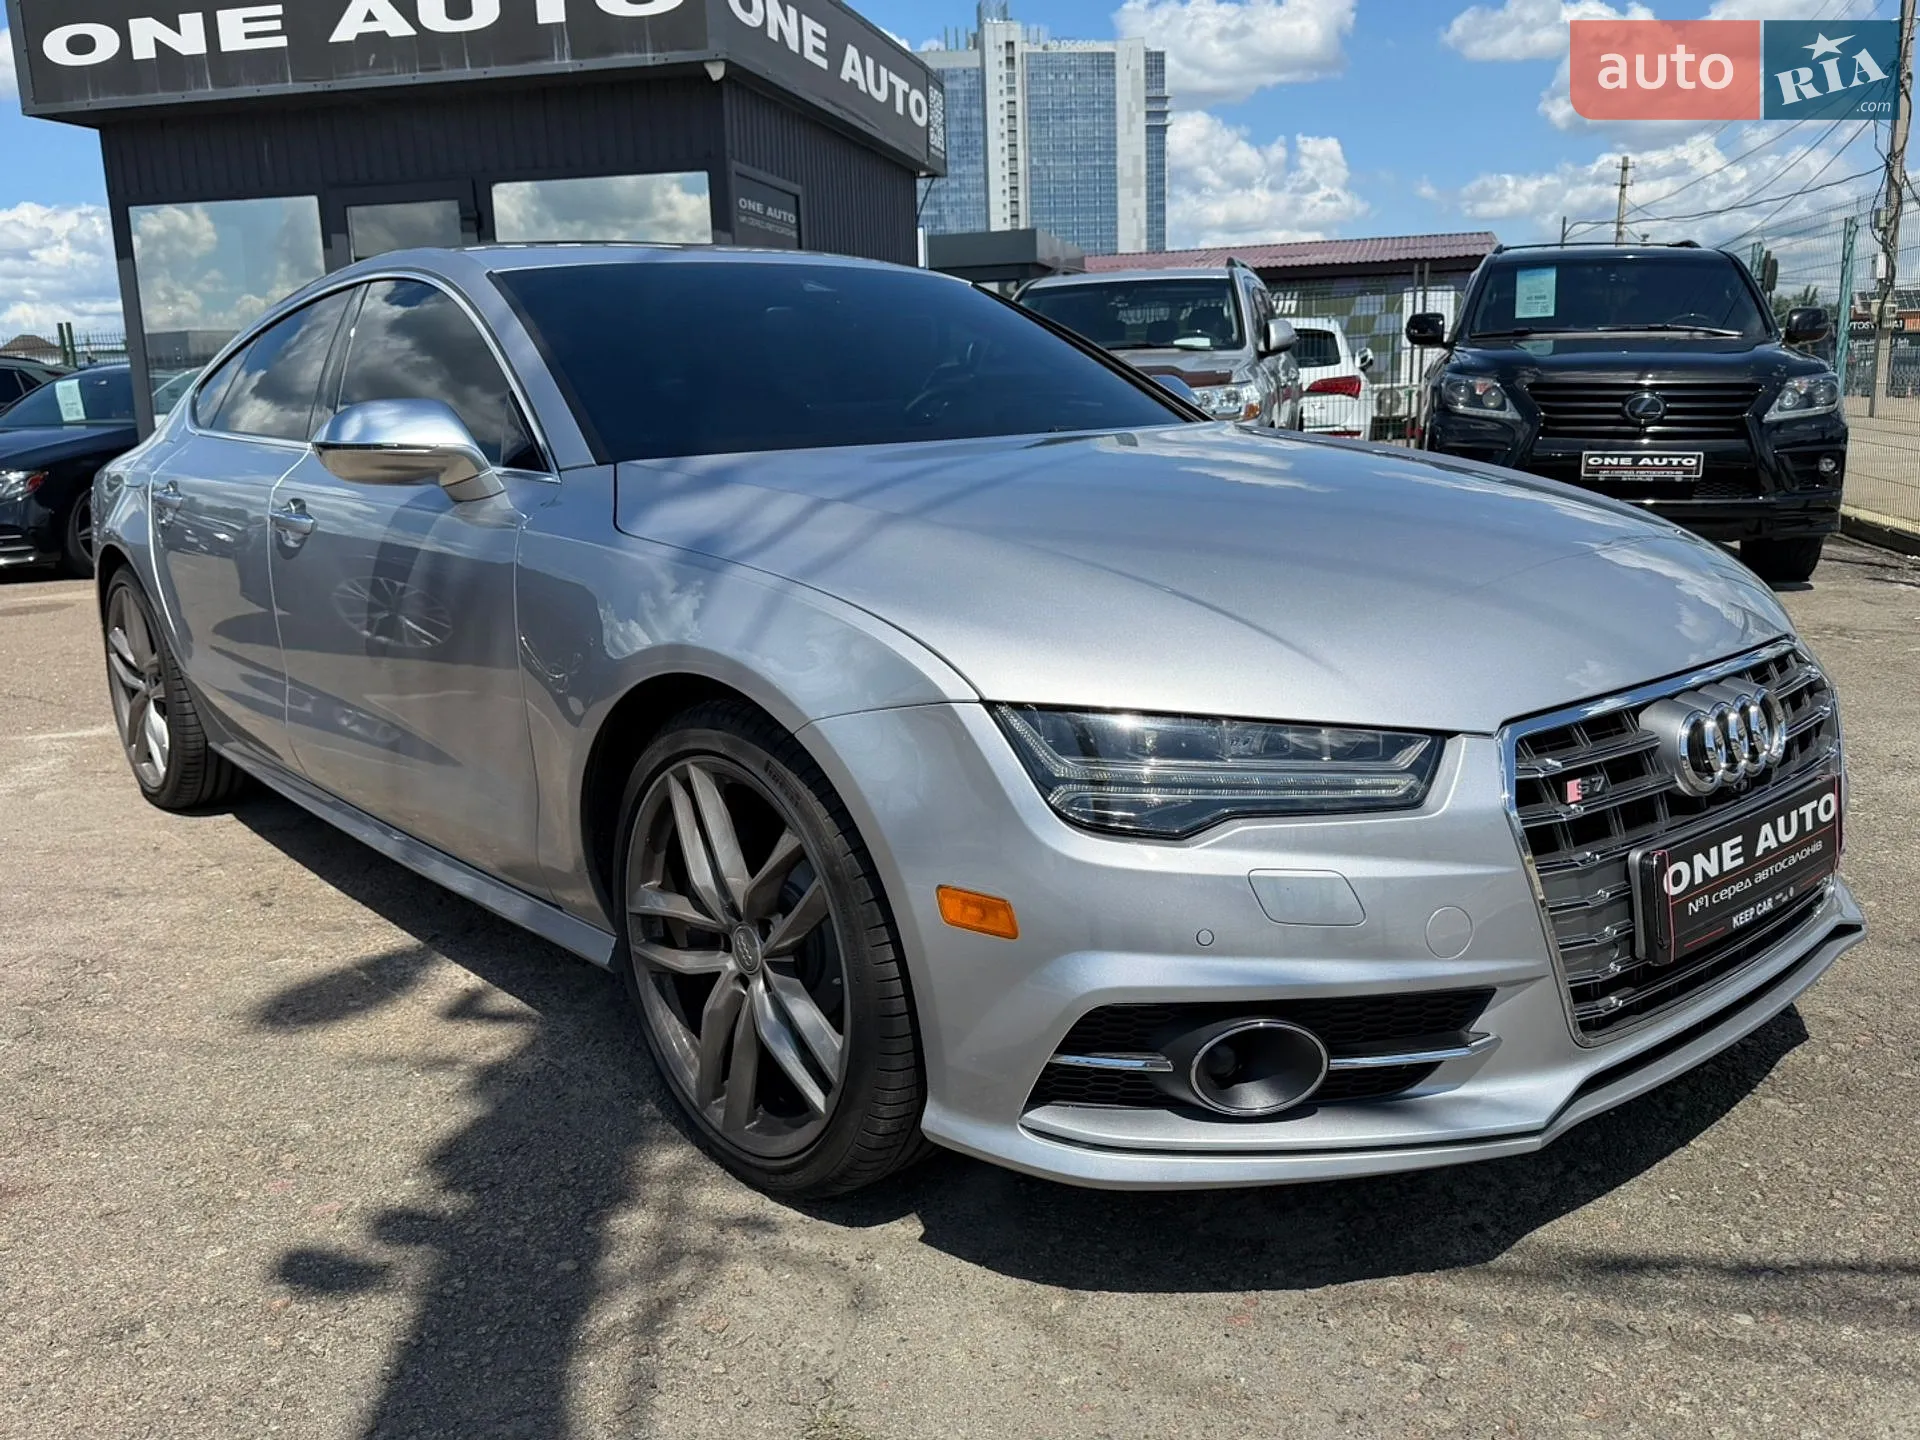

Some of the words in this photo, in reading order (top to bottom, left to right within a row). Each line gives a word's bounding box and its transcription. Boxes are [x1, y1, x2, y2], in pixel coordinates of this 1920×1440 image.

[42, 4, 288, 67] ONE
[728, 0, 829, 71] ONE
[840, 43, 928, 128] AUTO
[738, 197, 764, 214] ONE
[766, 206, 796, 224] AUTO
[1588, 457, 1633, 466] ONE
[1638, 457, 1697, 466] AUTO
[1575, 774, 1605, 800] S7
[1663, 835, 1745, 896] ONE
[1755, 793, 1836, 857] AUTO
[1712, 879, 1752, 904] серед
[1754, 840, 1823, 884] автосалонів
[1732, 907, 1756, 929] KEEP
[1756, 897, 1774, 916] CAR
